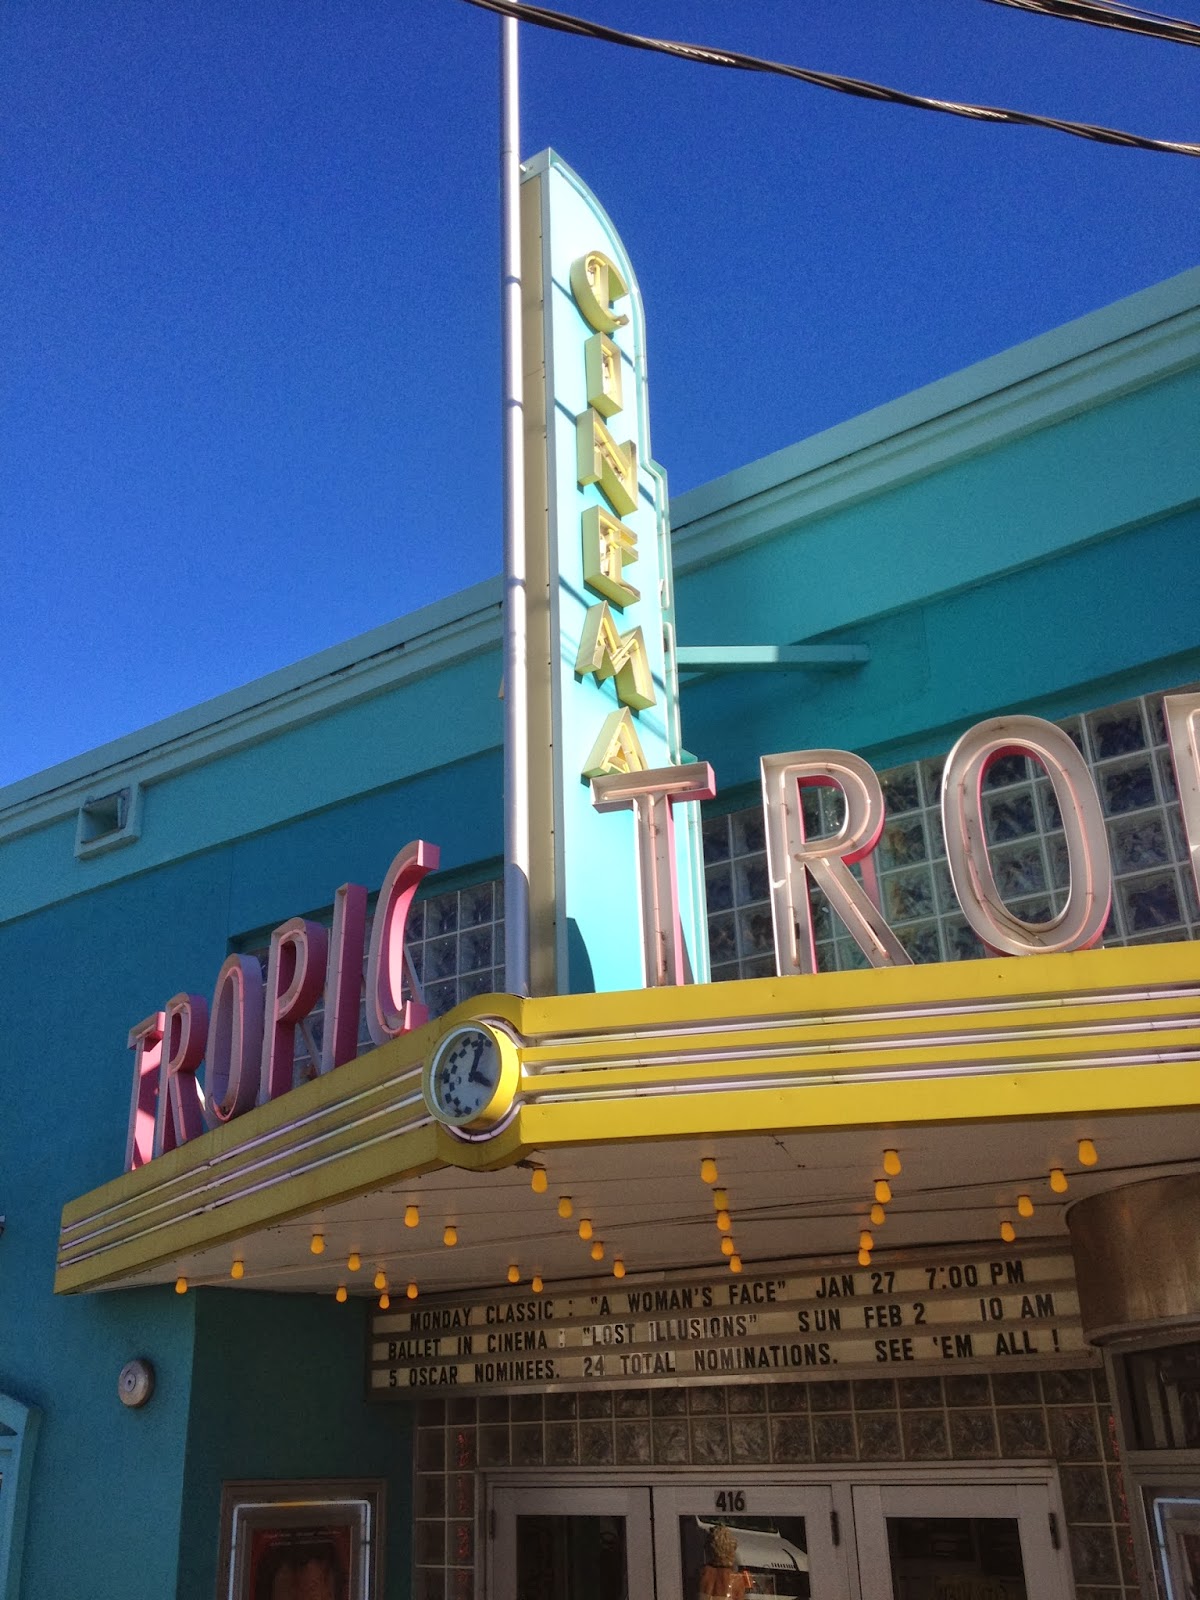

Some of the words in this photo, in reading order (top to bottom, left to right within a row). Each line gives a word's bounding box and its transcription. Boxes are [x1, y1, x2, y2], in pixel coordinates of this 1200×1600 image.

[570, 250, 656, 777] CINEMA
[591, 694, 1200, 988] TRO
[124, 839, 440, 1173] TROPIC
[388, 1338, 441, 1361] BALLET
[457, 1336, 473, 1356] IN
[487, 1329, 549, 1354] CINEMA
[583, 1323, 635, 1346] "LOST
[650, 1314, 757, 1343] ILLUSIONS"
[798, 1309, 841, 1333] SUN
[864, 1304, 902, 1329] FEB
[913, 1302, 926, 1325] 2
[980, 1298, 1003, 1322] 10
[1021, 1294, 1055, 1319] AM
[410, 1308, 472, 1332] MONDAY
[486, 1300, 554, 1325] CLASSIC
[590, 1296, 611, 1316] "A
[628, 1287, 713, 1314] WOMAN'S
[729, 1281, 786, 1305] FACE"
[816, 1275, 855, 1299] JAN
[871, 1271, 895, 1295] 27
[925, 1264, 978, 1291] 7:00
[990, 1260, 1026, 1285] PM
[389, 1369, 398, 1388] 5
[409, 1365, 458, 1387] OSCAR
[475, 1360, 560, 1384] NOMINEES.
[583, 1355, 605, 1377] 24
[620, 1352, 676, 1376] TOTAL
[695, 1343, 839, 1372] NOMINATIONS.
[875, 1338, 915, 1363] SEE
[933, 1334, 974, 1359] 'EM
[996, 1330, 1038, 1356] ALL
[715, 1490, 745, 1512] 416
